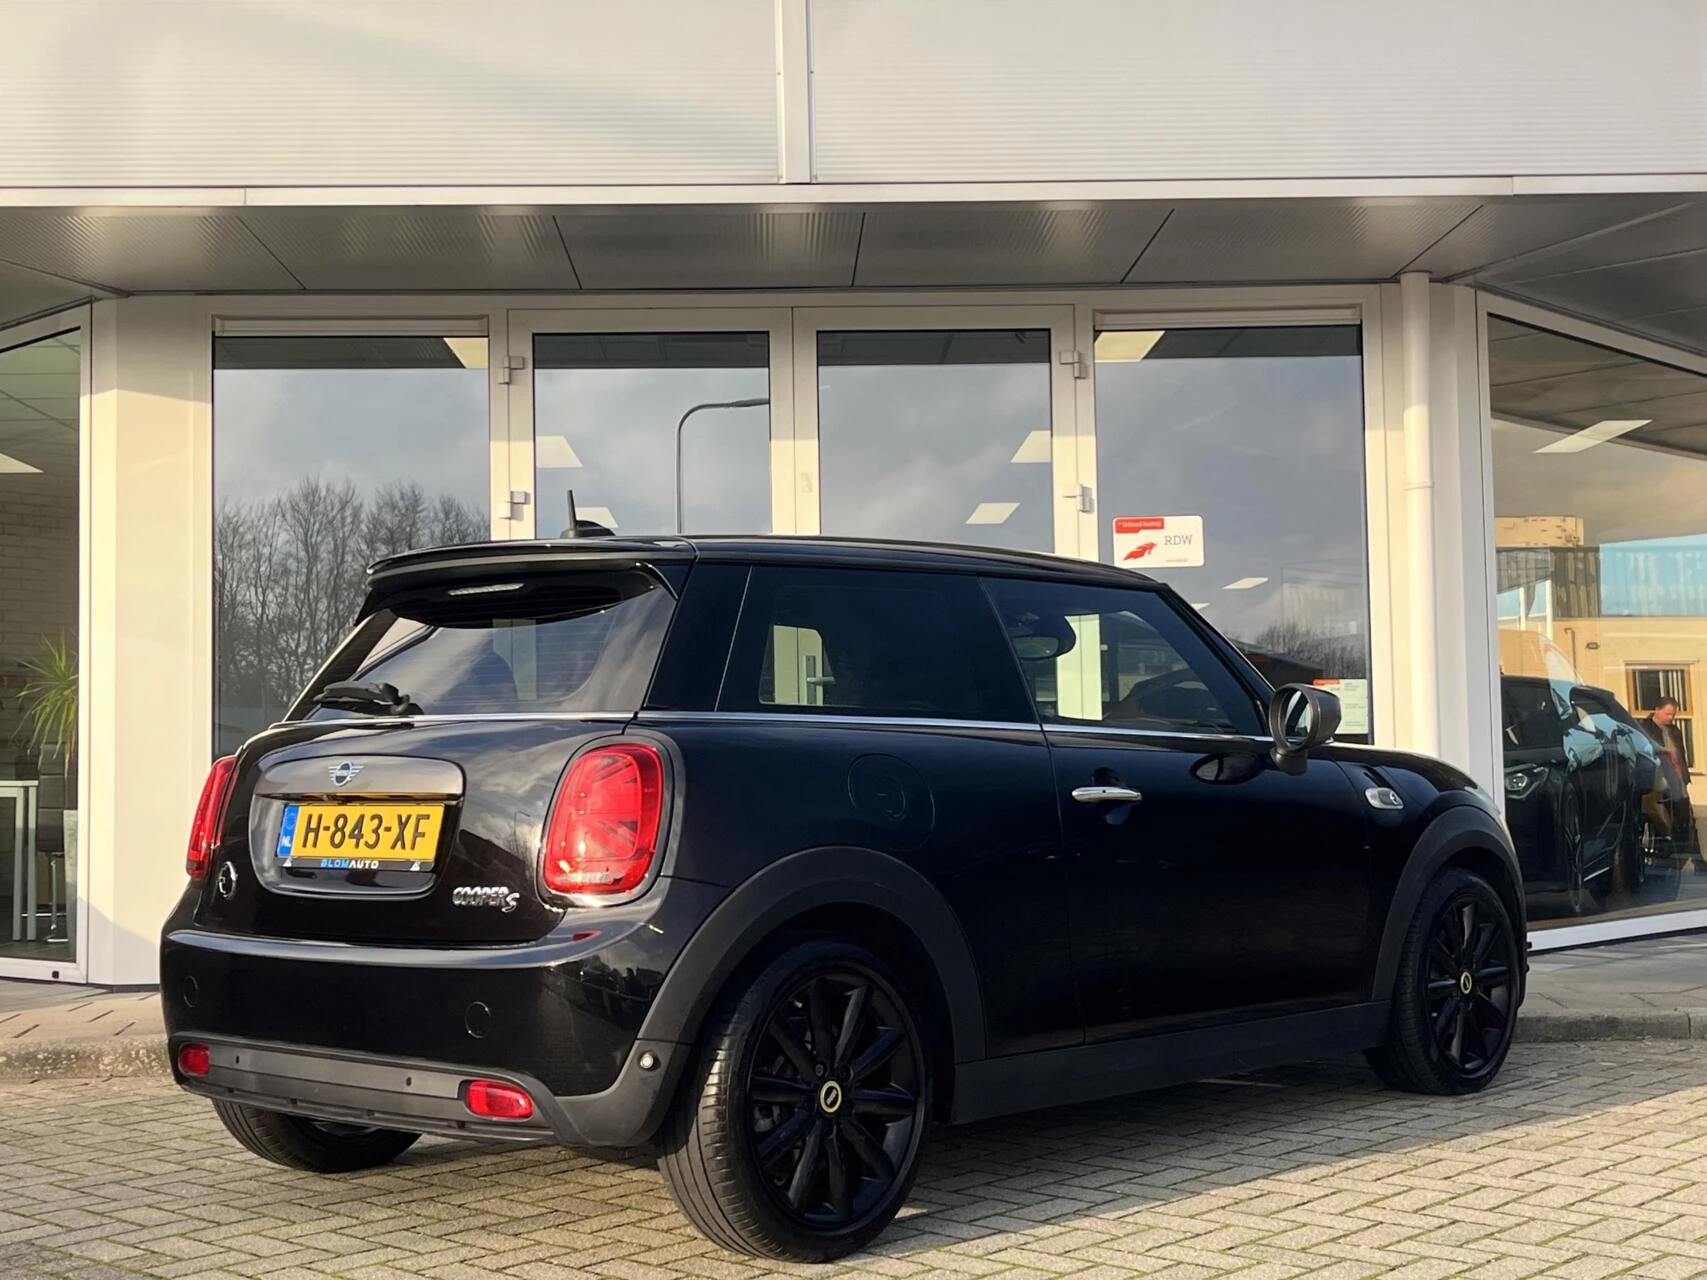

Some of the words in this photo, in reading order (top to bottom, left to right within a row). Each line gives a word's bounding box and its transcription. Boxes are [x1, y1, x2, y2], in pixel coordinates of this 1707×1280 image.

[1164, 534, 1193, 546] RDW
[302, 813, 431, 851] H-843-XF
[281, 835, 291, 847] NL
[452, 886, 509, 906] COOPER
